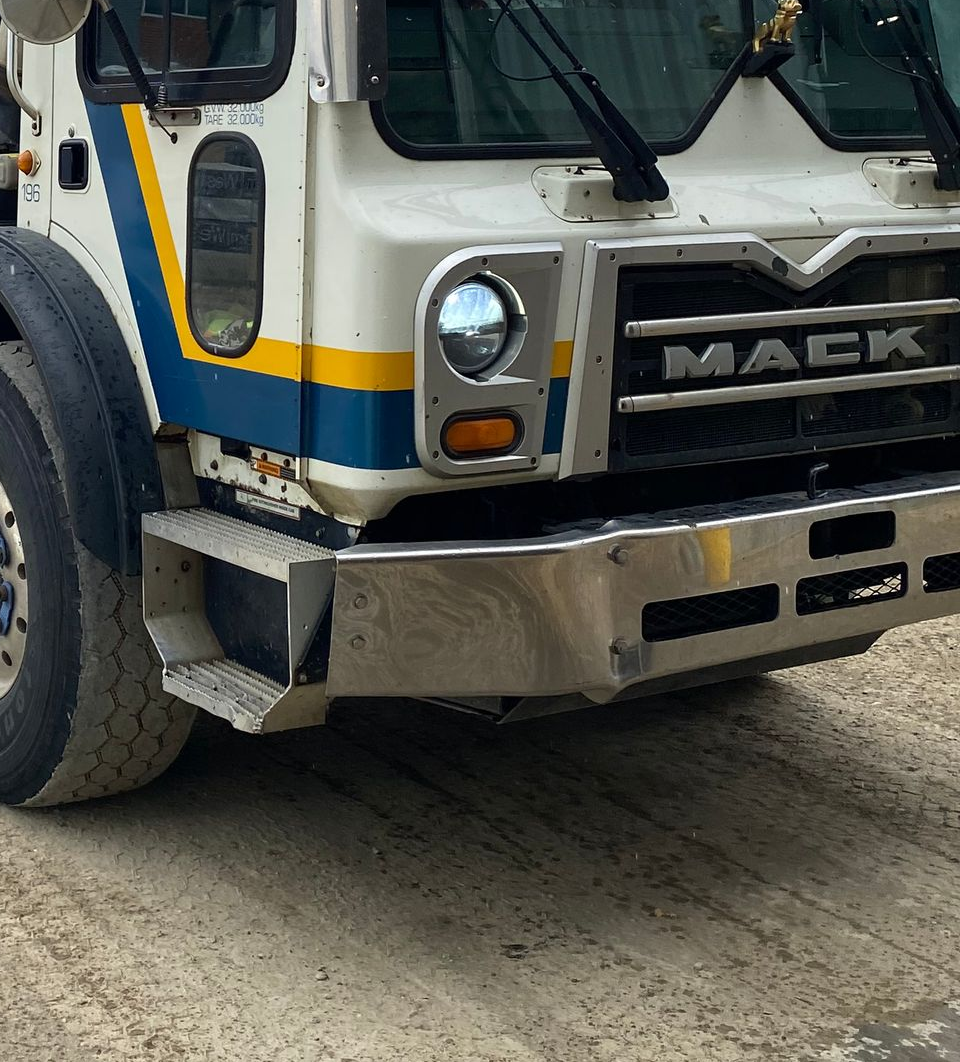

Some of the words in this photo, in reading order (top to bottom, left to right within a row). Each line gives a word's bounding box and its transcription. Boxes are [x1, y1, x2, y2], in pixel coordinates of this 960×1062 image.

[204, 114, 224, 125] TARE
[21, 183, 40, 203] 196
[662, 325, 927, 381] MACK
